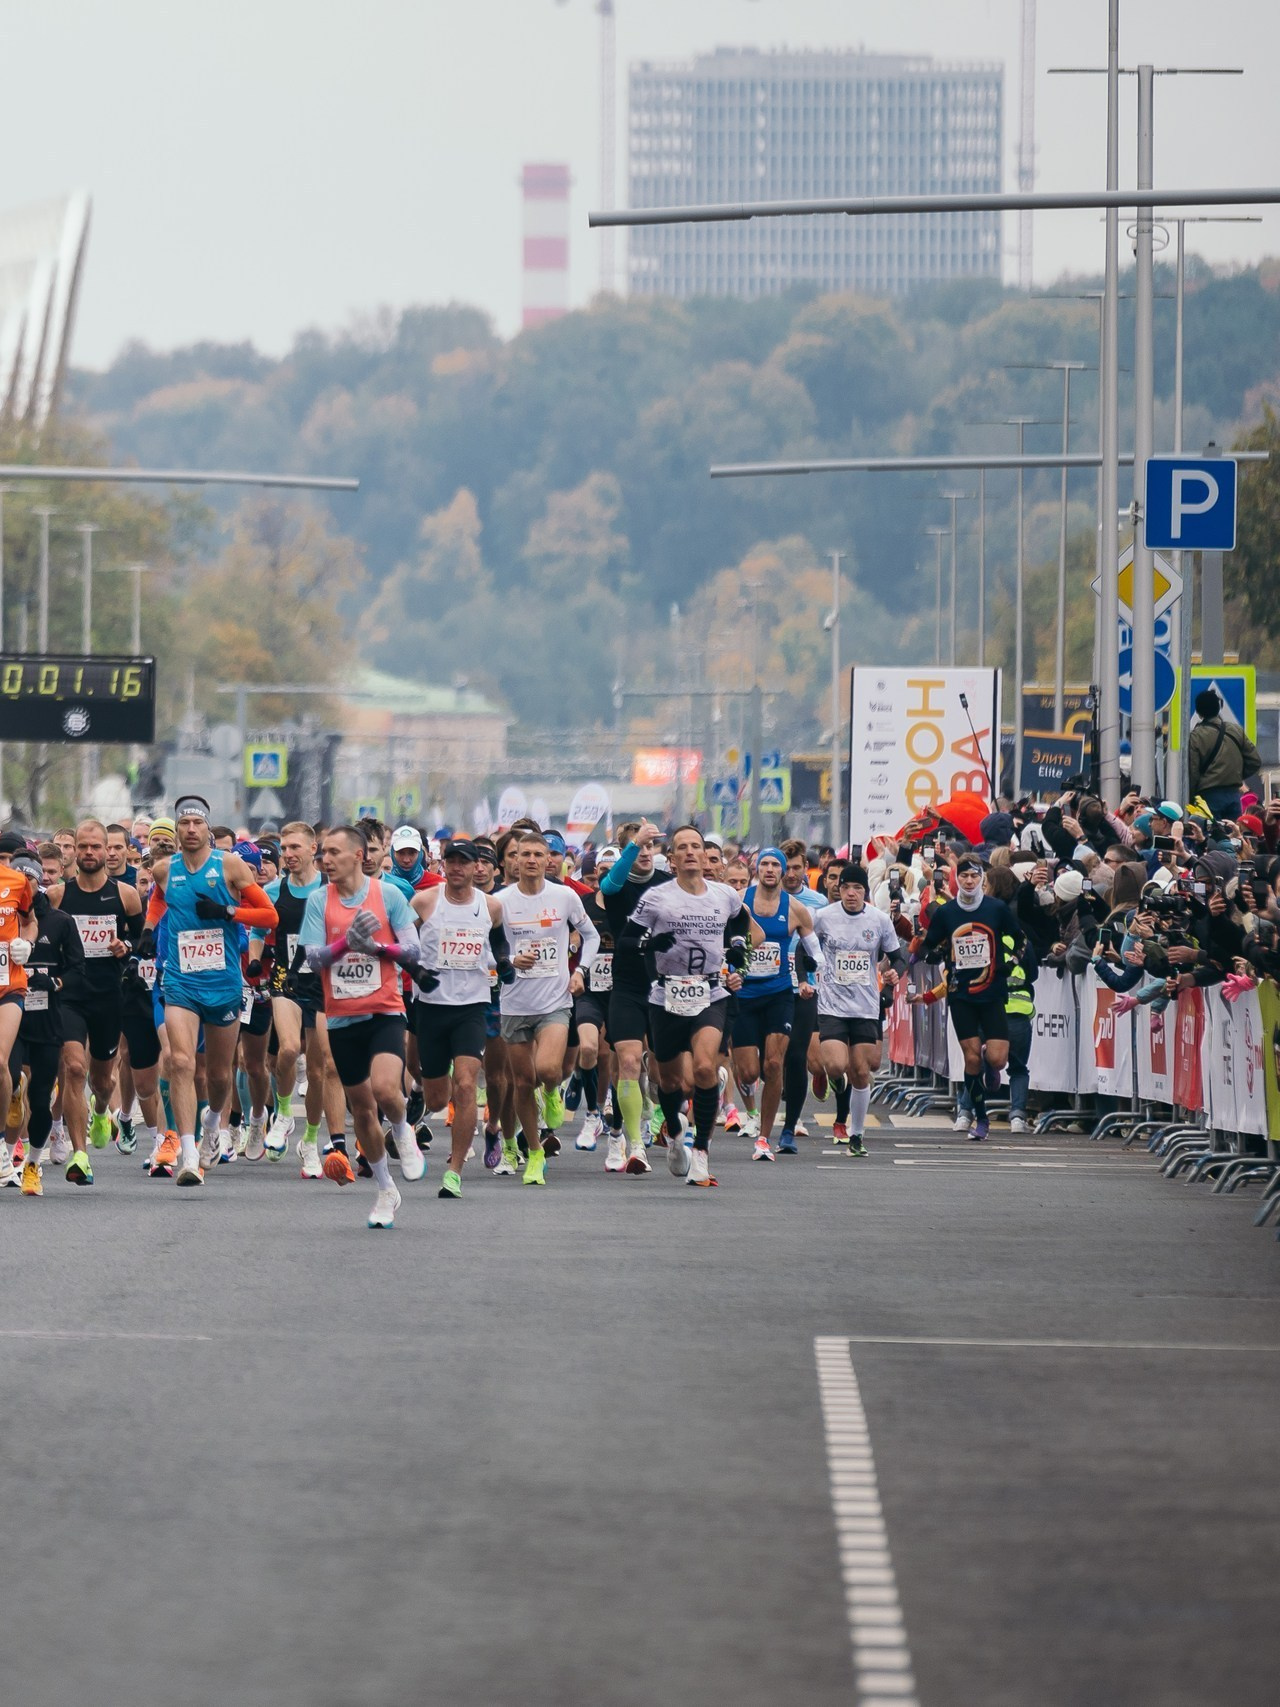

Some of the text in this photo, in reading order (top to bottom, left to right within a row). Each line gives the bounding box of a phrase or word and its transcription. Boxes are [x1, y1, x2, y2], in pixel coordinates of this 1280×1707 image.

[1171, 469, 1219, 539] P
[905, 679, 946, 817] ФОН
[950, 727, 990, 804] ВА
[1032, 749, 1072, 767] Элита
[1038, 765, 1063, 778] Elite
[667, 921, 704, 929] TRAINING
[181, 943, 223, 959] 17495
[441, 941, 482, 956] 17298
[958, 943, 984, 956] 8137
[337, 964, 374, 979] 4409
[837, 959, 869, 971] 13065
[670, 985, 705, 999] 9603
[1036, 1013, 1070, 1039] CHERY
